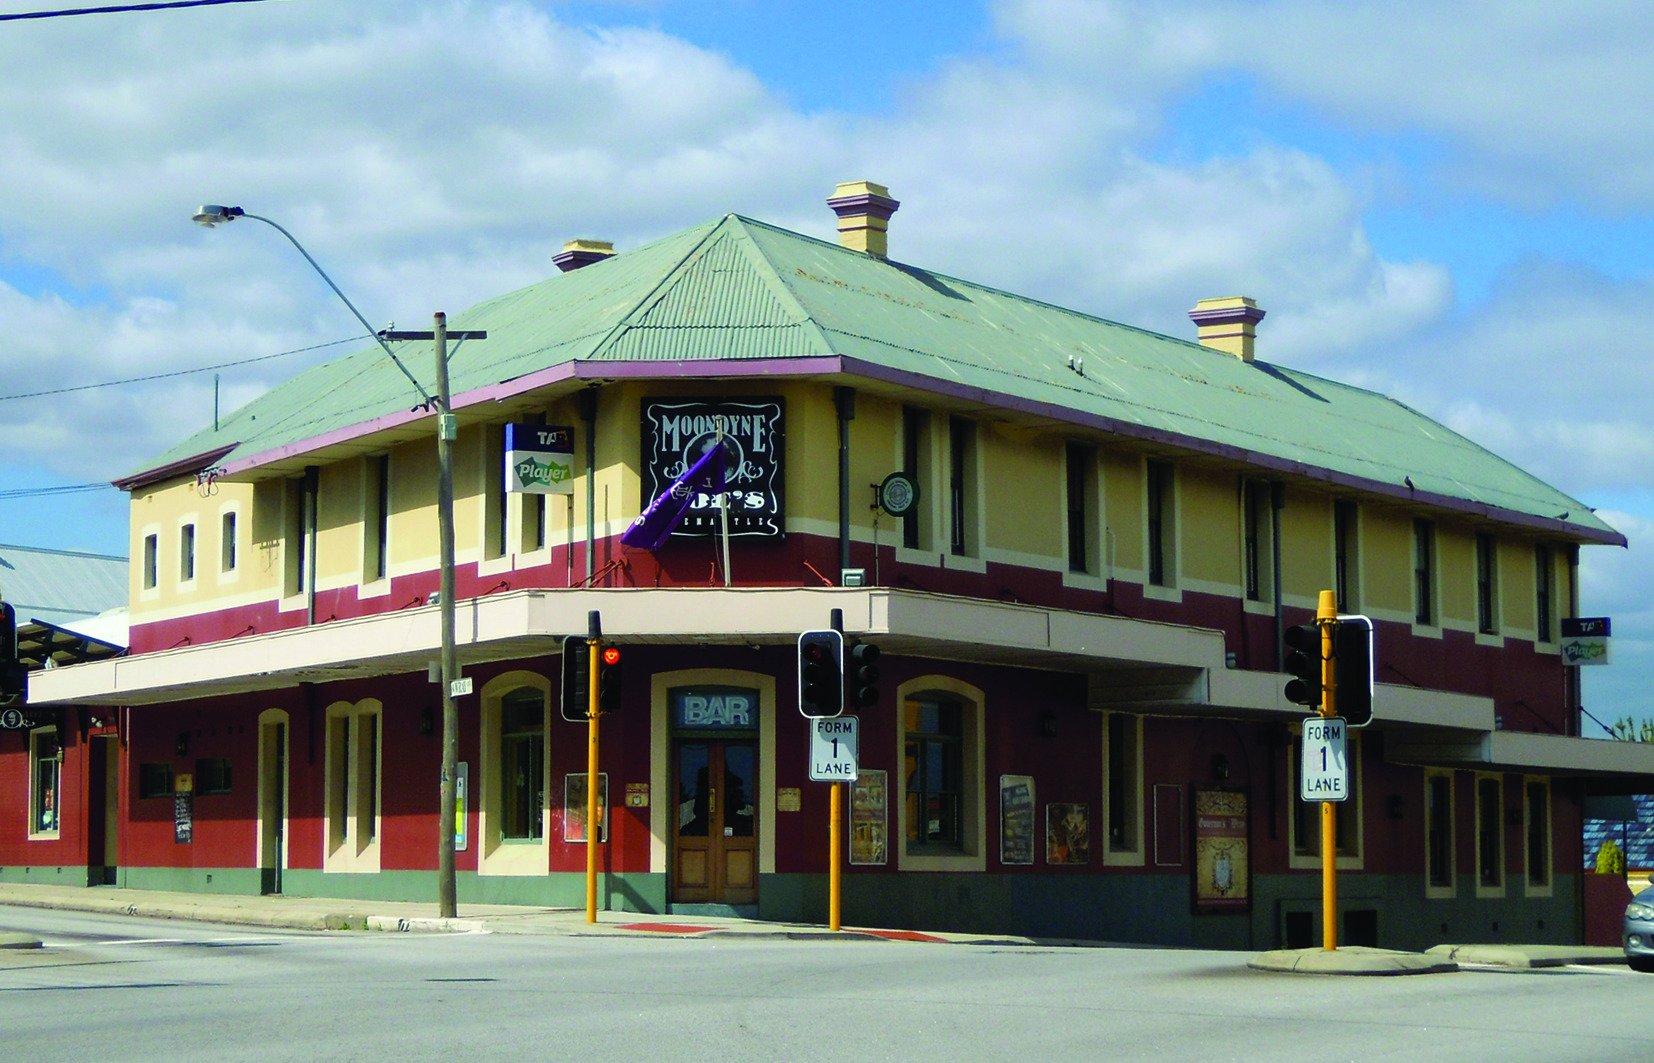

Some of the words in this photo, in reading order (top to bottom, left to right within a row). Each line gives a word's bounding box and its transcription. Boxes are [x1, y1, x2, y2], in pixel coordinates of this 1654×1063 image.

[662, 414, 766, 452] MOONDYNE
[519, 464, 567, 483] Player
[690, 490, 765, 509] OE'S
[685, 696, 749, 725] BAR
[817, 721, 852, 734] FORM
[1308, 726, 1341, 740] FORM
[831, 737, 838, 758] 1
[1320, 745, 1327, 772] 1
[816, 762, 851, 775] LANE
[1307, 778, 1341, 792] LANE
